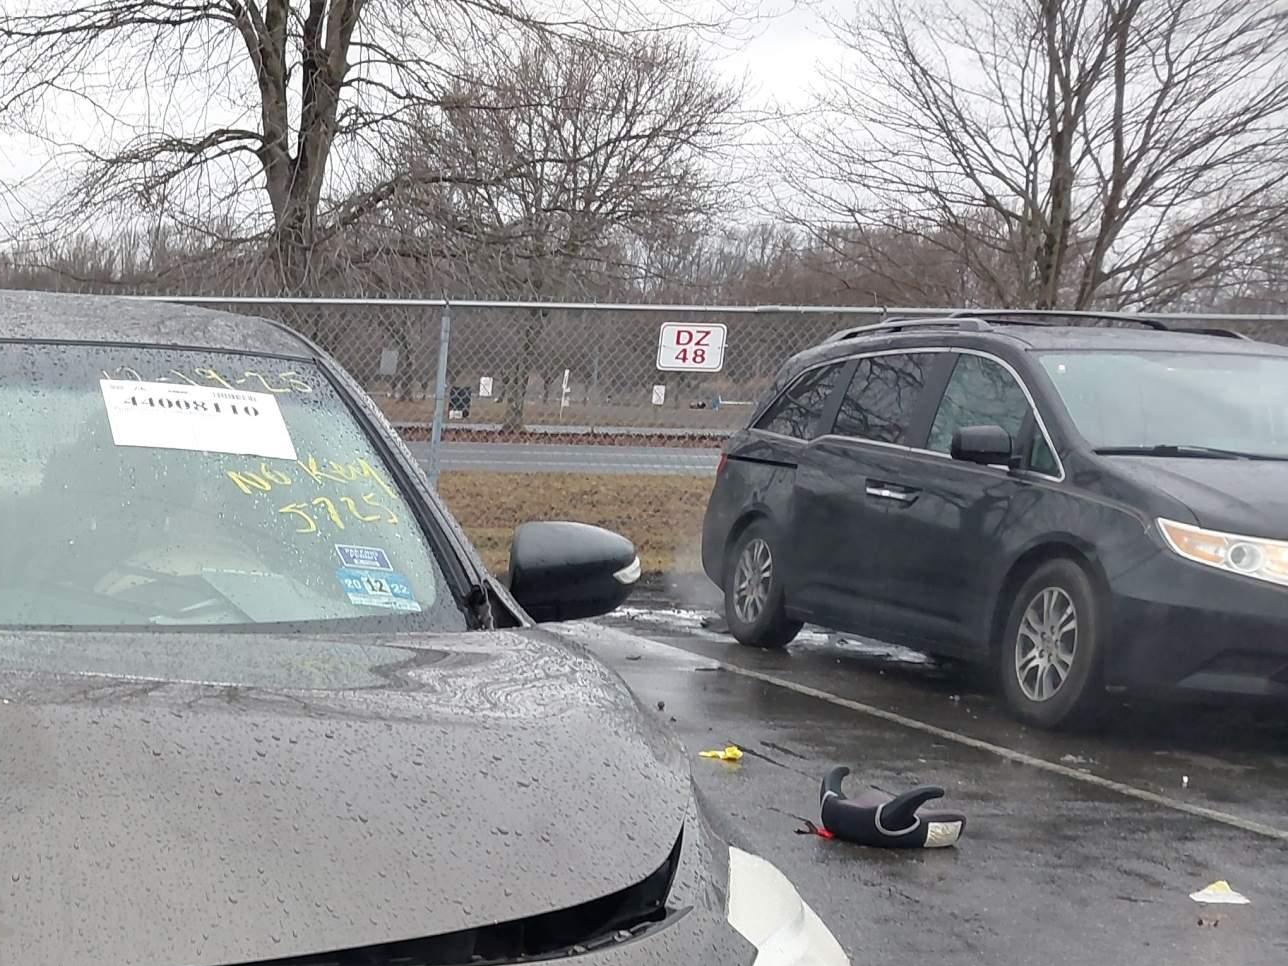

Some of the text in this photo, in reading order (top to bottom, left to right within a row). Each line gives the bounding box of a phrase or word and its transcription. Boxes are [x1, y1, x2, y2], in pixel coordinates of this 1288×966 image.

[675, 329, 711, 347] DZ
[674, 347, 706, 364] 48
[123, 395, 260, 417] 44008110
[366, 577, 389, 593] 12
